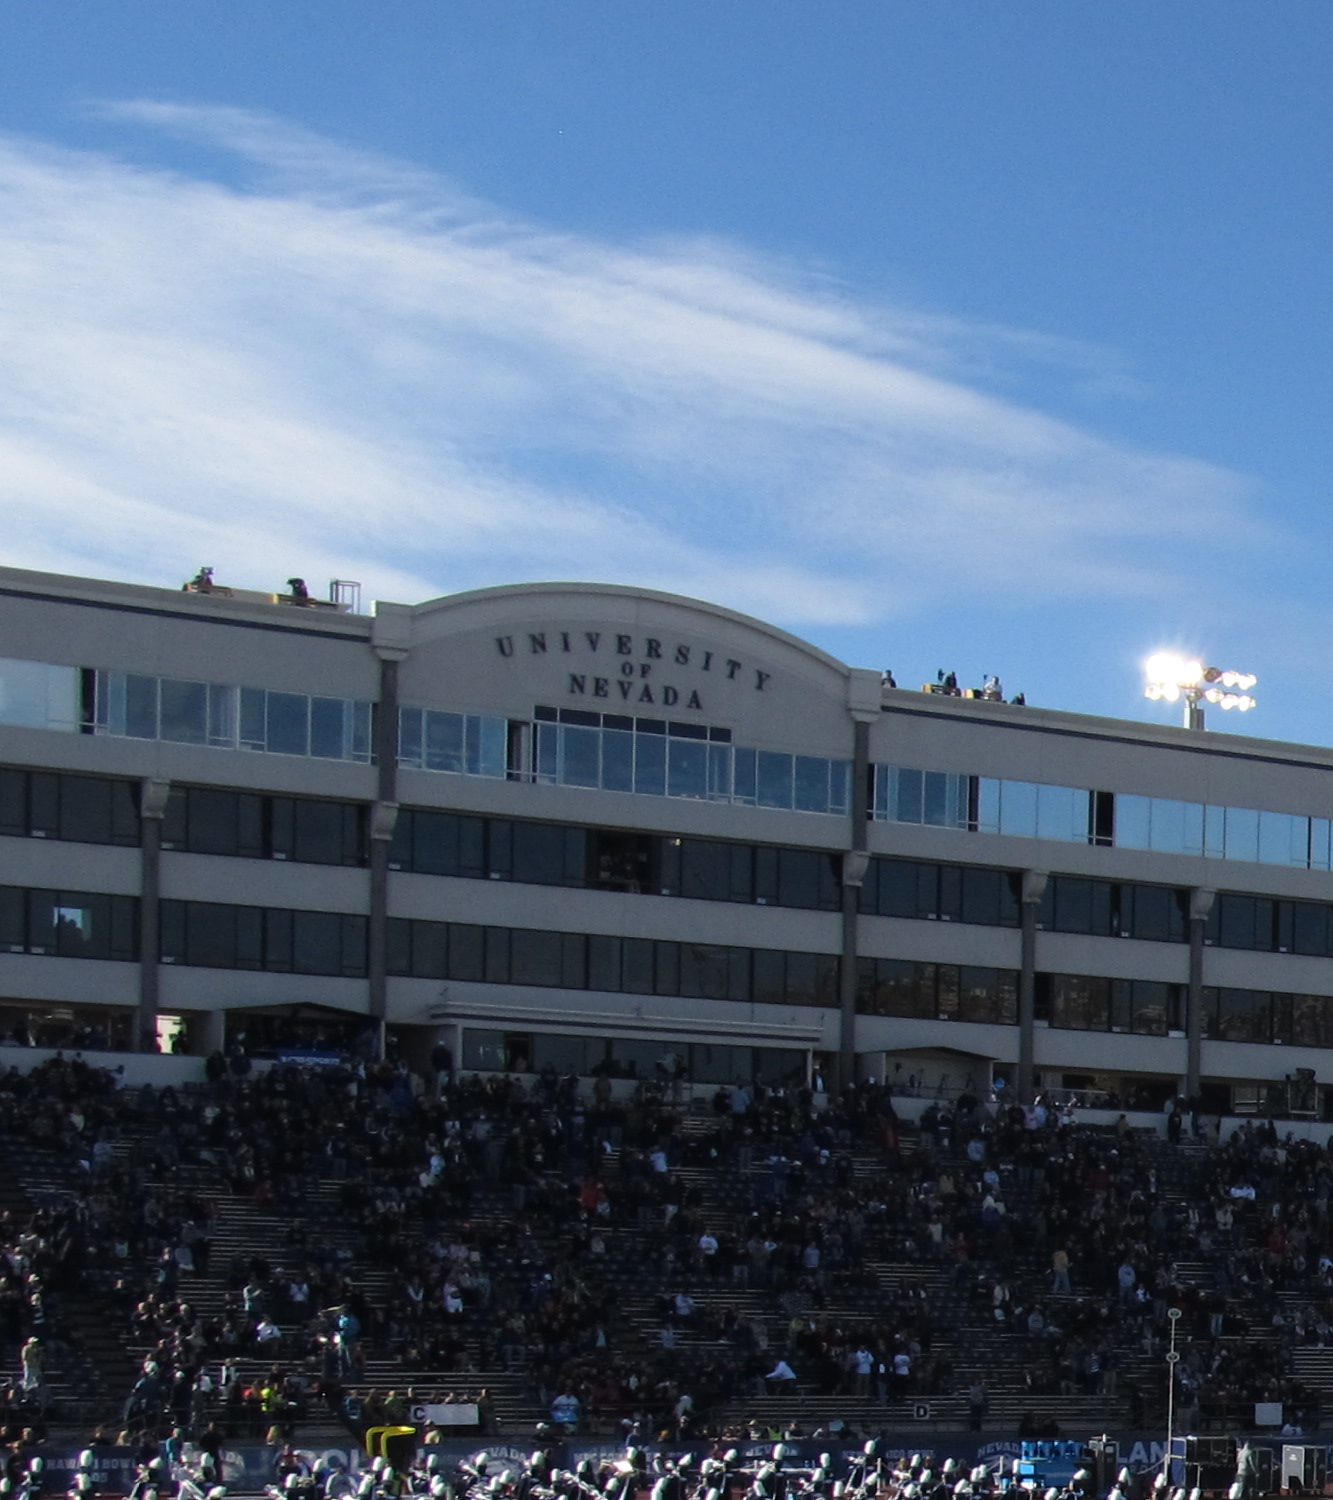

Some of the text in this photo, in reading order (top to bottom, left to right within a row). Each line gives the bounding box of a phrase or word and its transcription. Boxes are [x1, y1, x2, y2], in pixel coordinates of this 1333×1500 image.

[496, 632, 771, 692] UNIVERSITY
[621, 661, 651, 679] OF
[569, 674, 703, 710] NEVADA
[912, 1405, 926, 1417] D
[978, 1441, 1021, 1457] NEVAD
